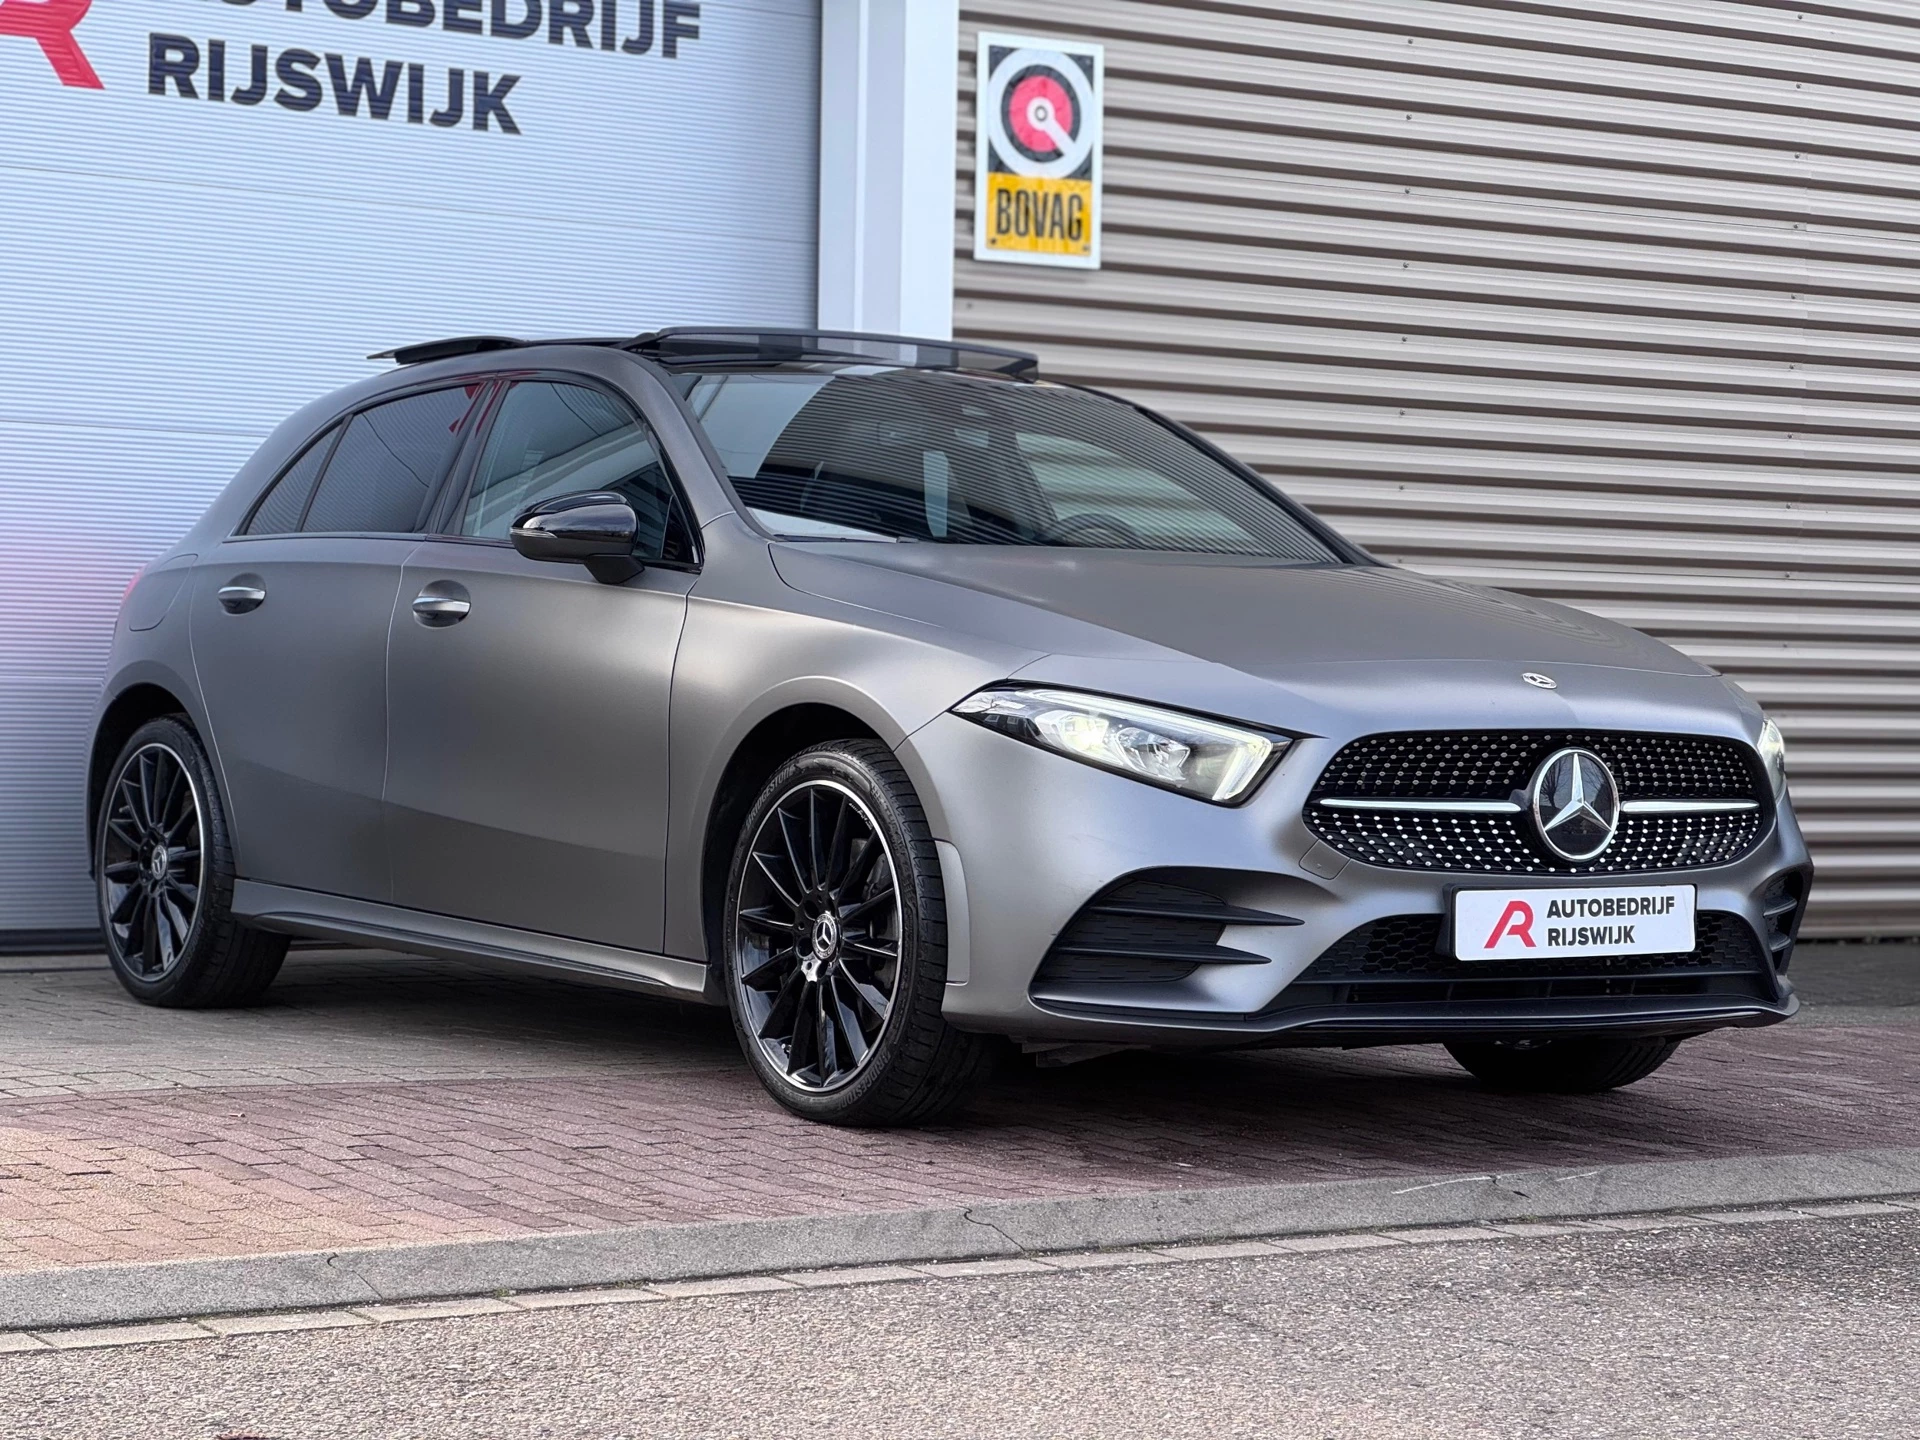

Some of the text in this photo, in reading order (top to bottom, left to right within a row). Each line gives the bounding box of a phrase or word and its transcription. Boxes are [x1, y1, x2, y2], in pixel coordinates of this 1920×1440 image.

[204, 0, 700, 59] EDRIJF
[147, 32, 522, 135] RIJSWIJK
[996, 188, 1084, 242] BOVAG
[1546, 896, 1675, 918] AUTOBEDRIJF
[1547, 925, 1635, 946] RIJSWIJK
